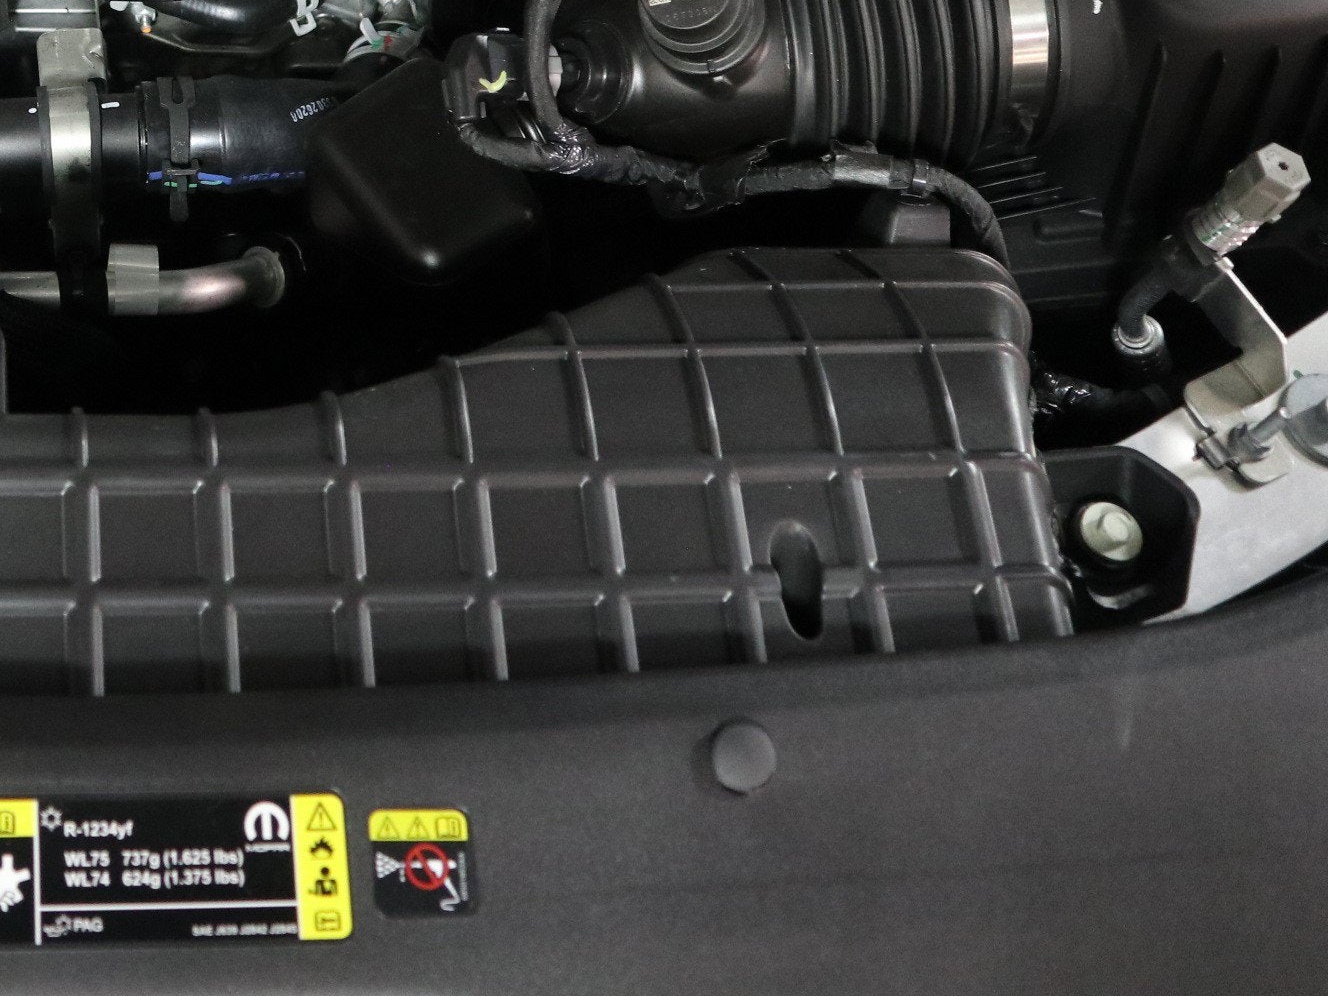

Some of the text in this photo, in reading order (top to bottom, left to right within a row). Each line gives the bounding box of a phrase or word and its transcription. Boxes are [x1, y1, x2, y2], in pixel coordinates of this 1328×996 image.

[63, 819, 134, 841] R-1234yf
[63, 849, 111, 868] WL75
[121, 849, 161, 870] 737g
[162, 848, 212, 870] (1.625
[212, 847, 245, 868] lbs)
[63, 867, 246, 890] WL74 624g (1.375 lbs)
[72, 915, 104, 933] PAG
